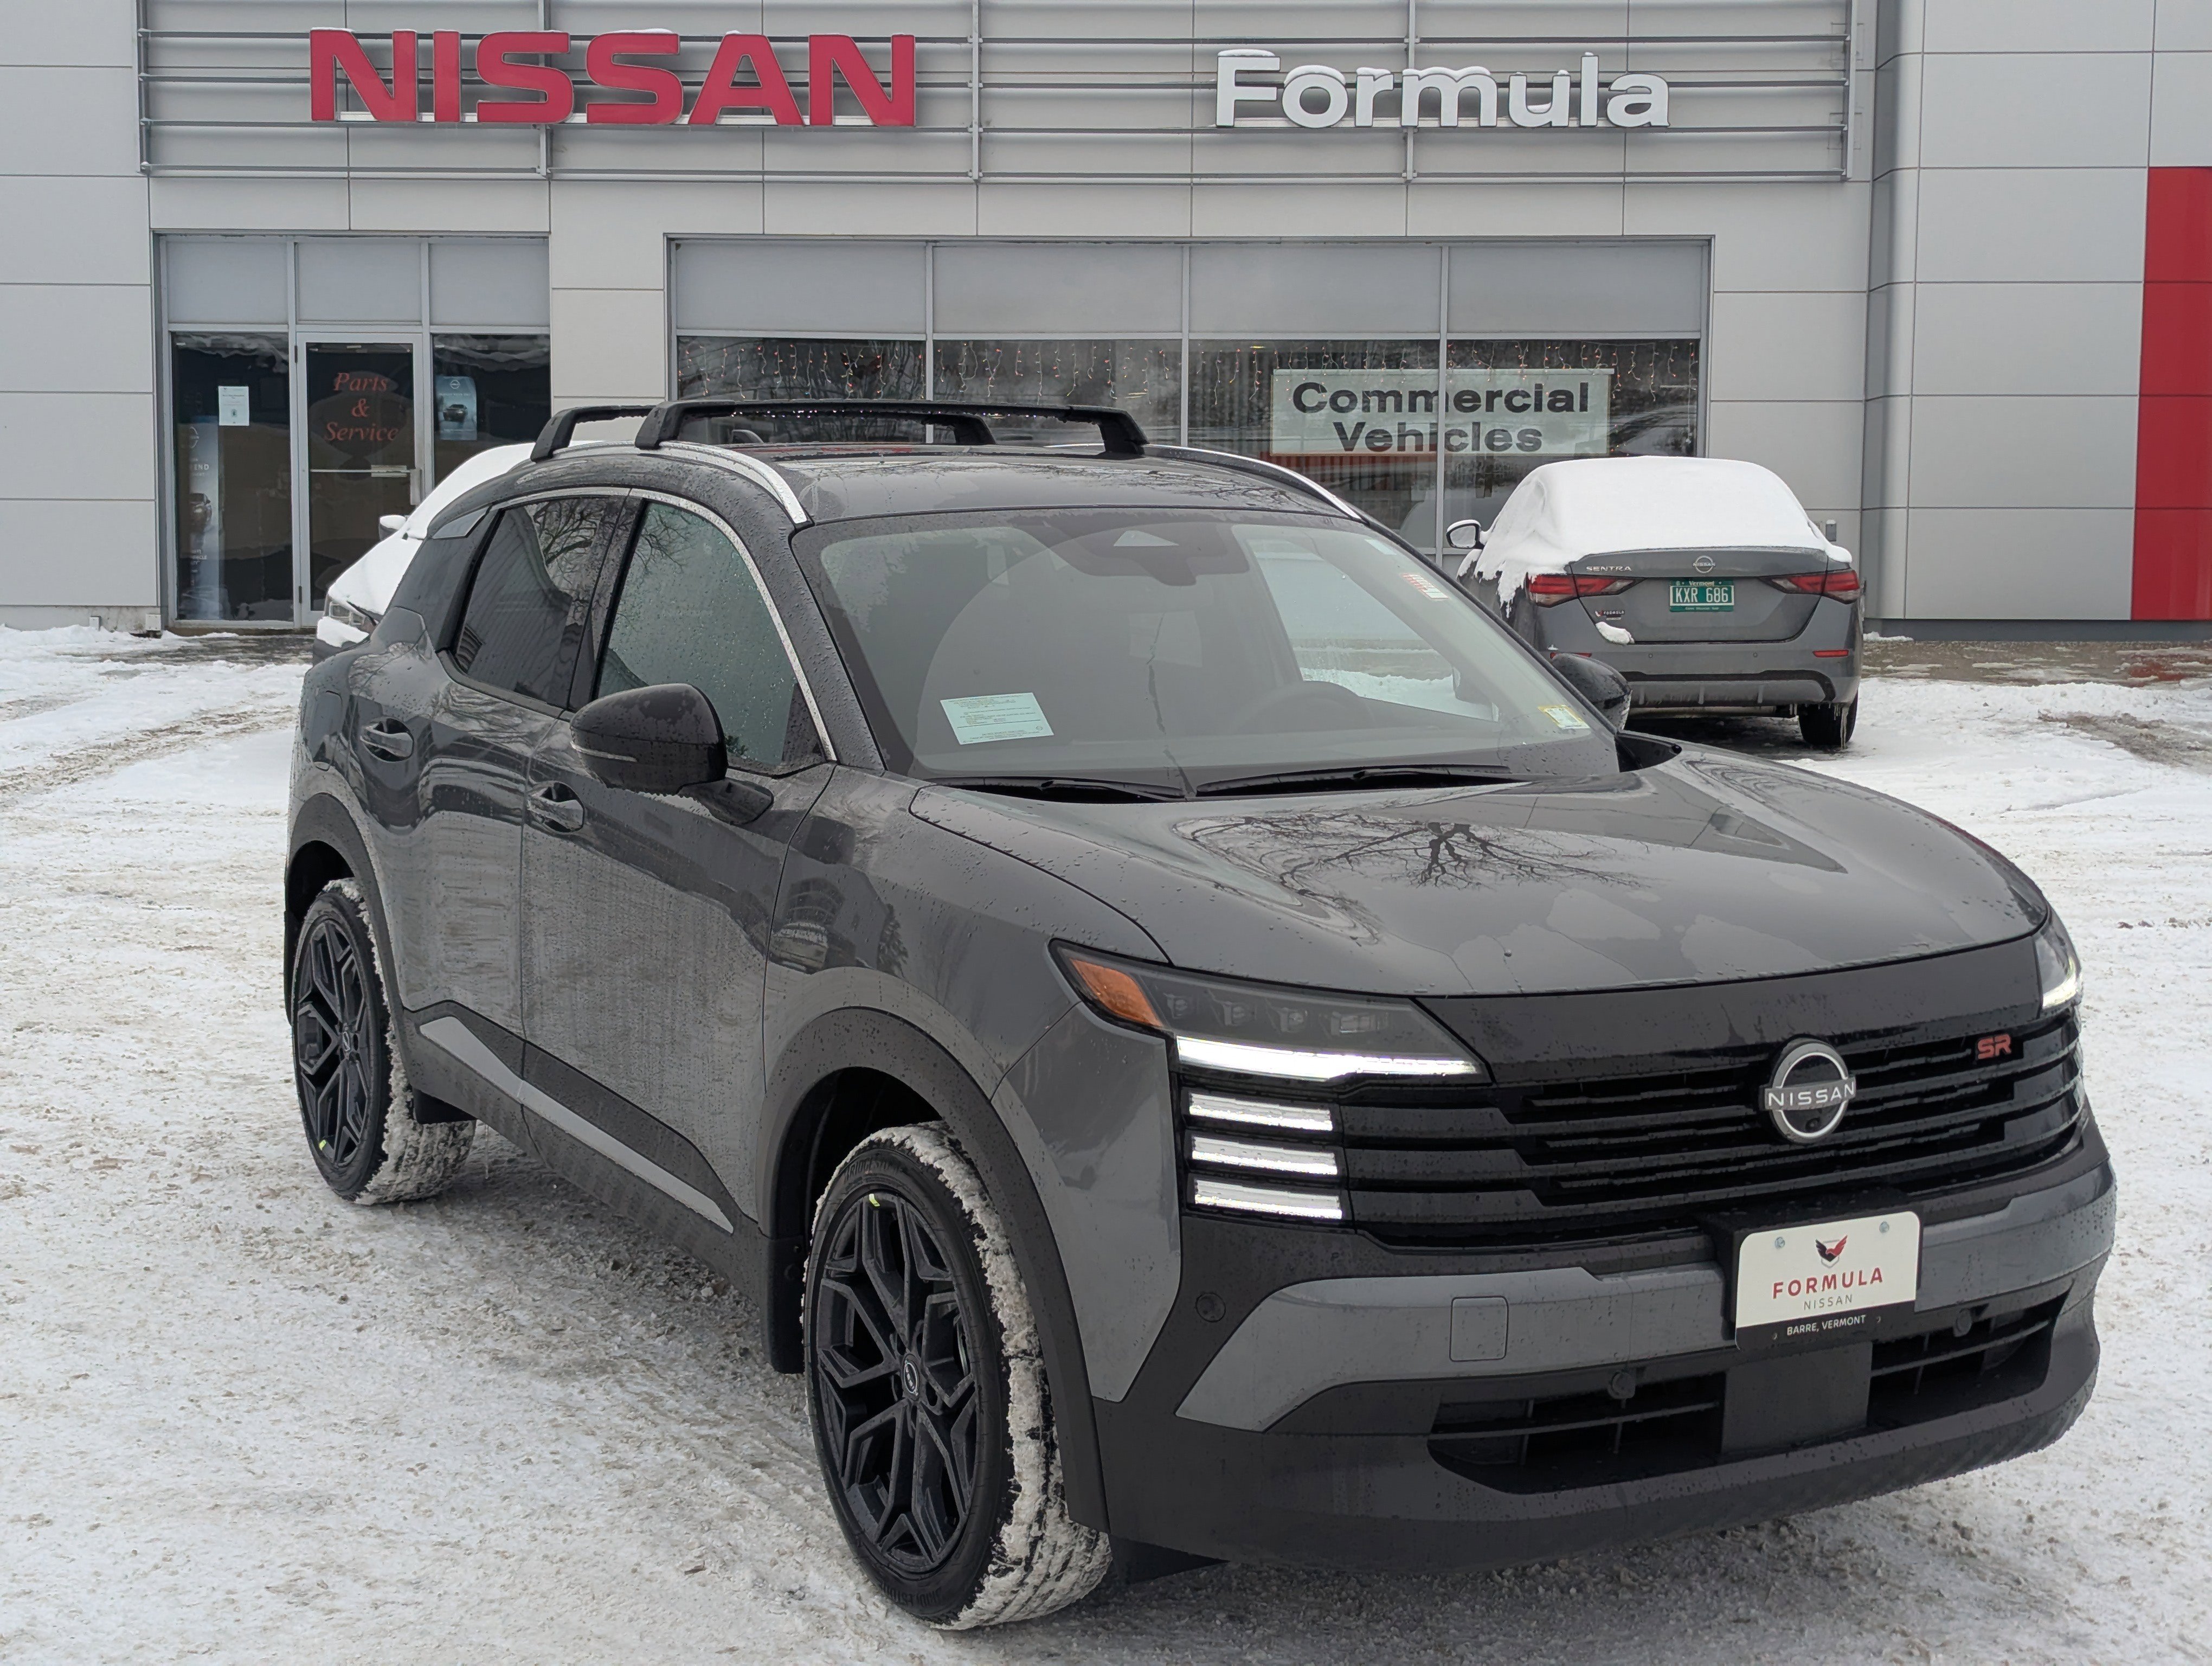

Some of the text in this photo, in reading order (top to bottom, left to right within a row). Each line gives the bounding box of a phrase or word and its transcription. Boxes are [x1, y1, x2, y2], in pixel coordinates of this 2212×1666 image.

[310, 29, 916, 126] NISSAN
[1216, 54, 1670, 128] Formula
[332, 372, 387, 391] Parts
[351, 399, 369, 417] &
[1292, 381, 1589, 413] Commercial
[324, 422, 399, 441] Service
[1332, 421, 1542, 452] Vehicles
[1675, 587, 1728, 603] KXR 686
[1977, 1034, 2012, 1060] SR
[1767, 1082, 1856, 1107] NISSAN
[1772, 1267, 1883, 1299] FORMULA
[1803, 1294, 1854, 1310] NISSAN
[1786, 1315, 1866, 1336] BARRE, VERMONT
